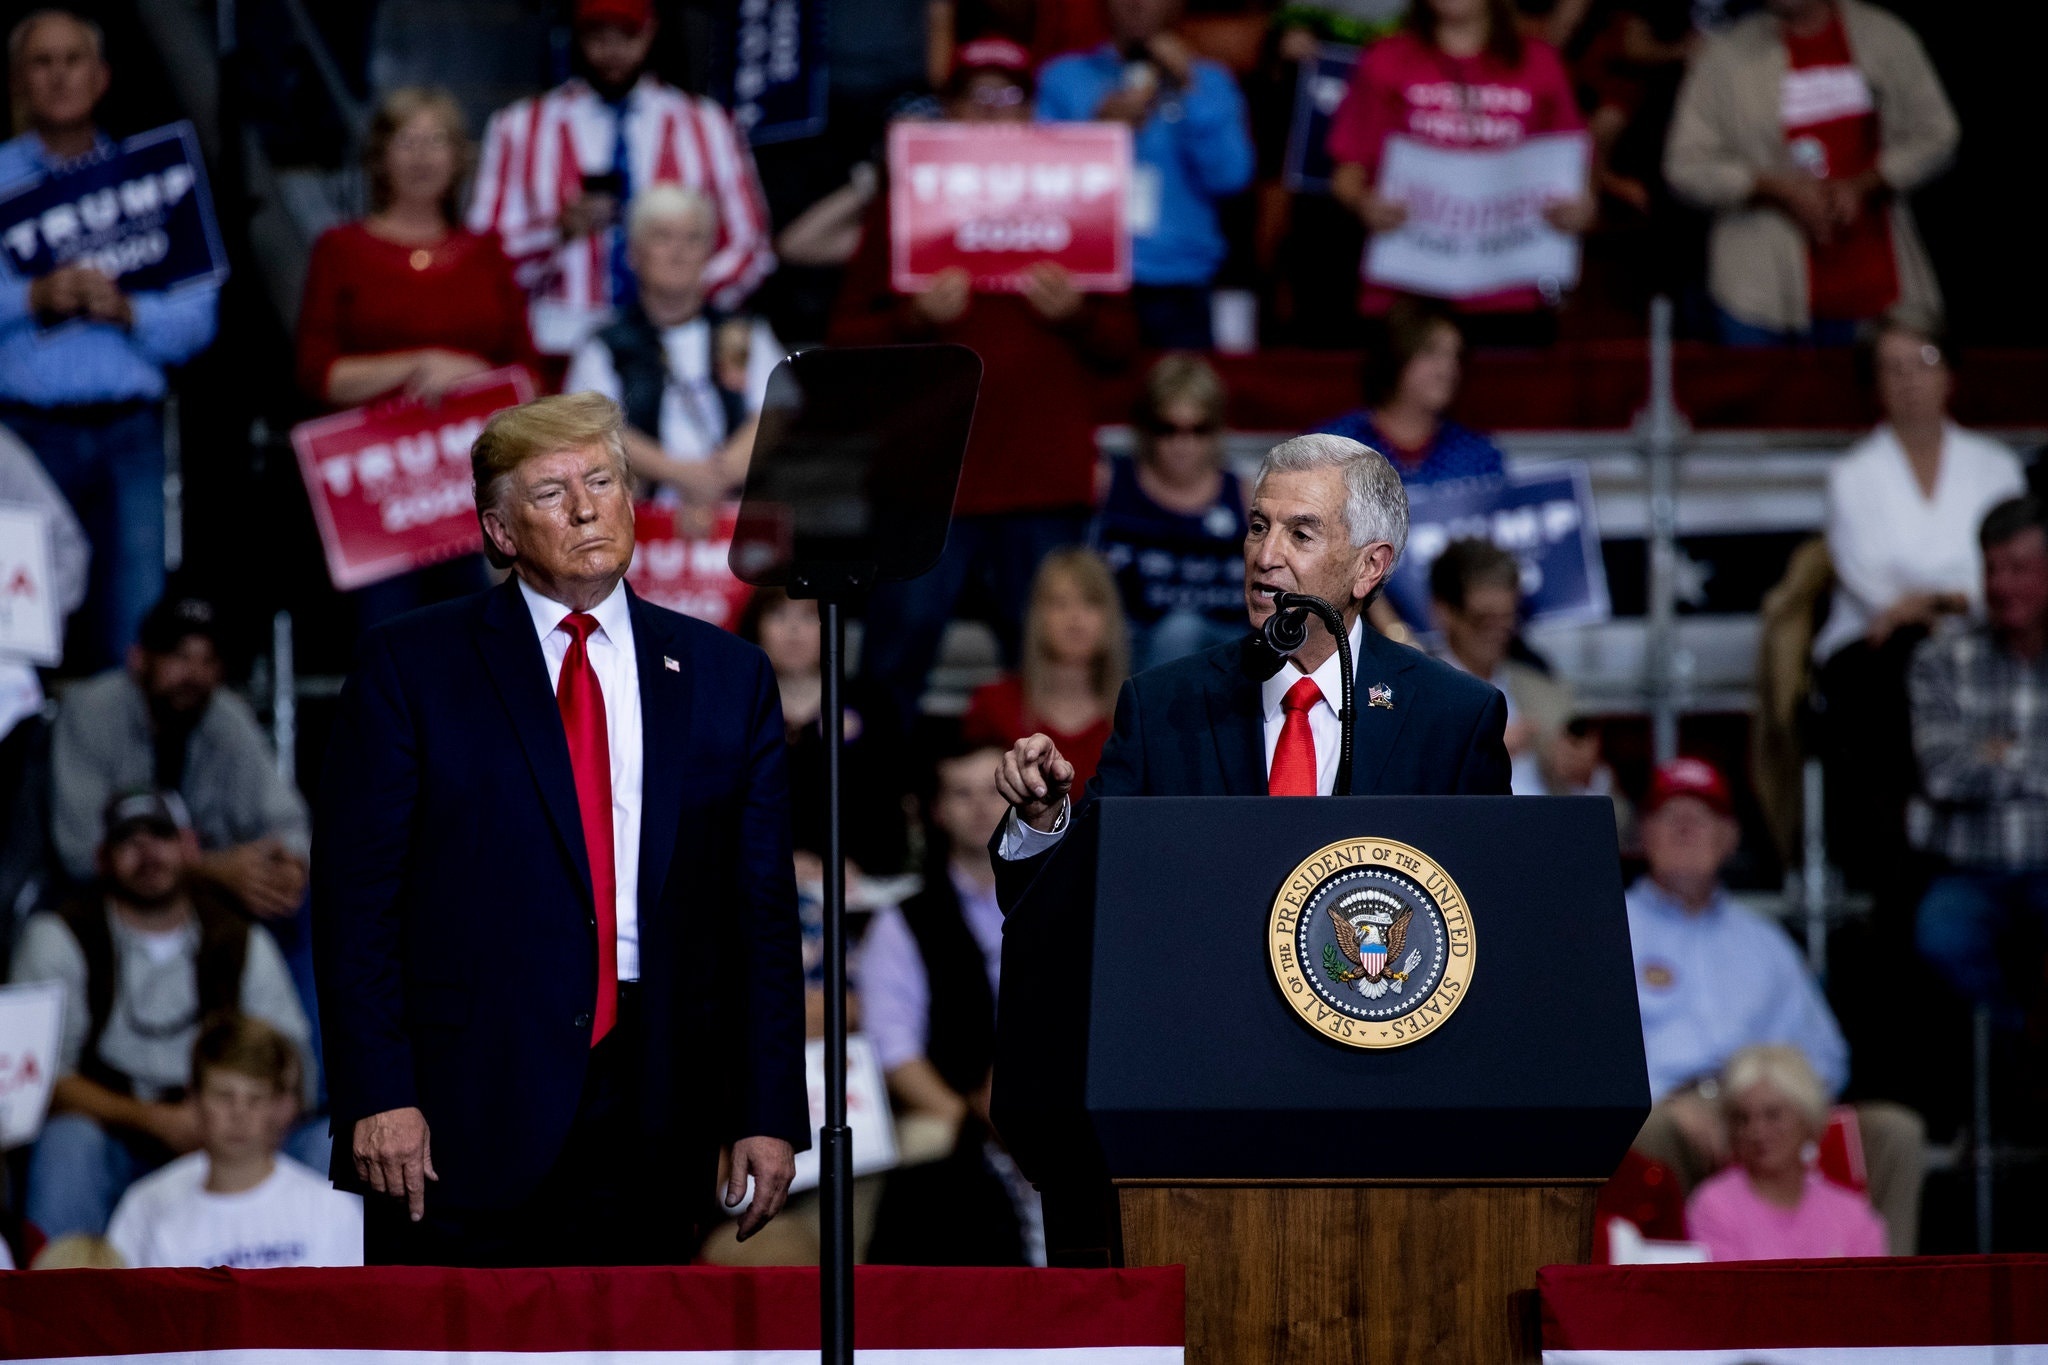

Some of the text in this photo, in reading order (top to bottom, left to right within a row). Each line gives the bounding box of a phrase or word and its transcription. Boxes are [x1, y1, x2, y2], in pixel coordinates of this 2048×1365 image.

[4, 163, 196, 261] TRUMP
[911, 161, 1117, 204] TRUMP
[322, 417, 482, 497] TRUM
[1276, 845, 1469, 1040] SEAL OF THE PRESIDENT OF THE UNITED STATES
